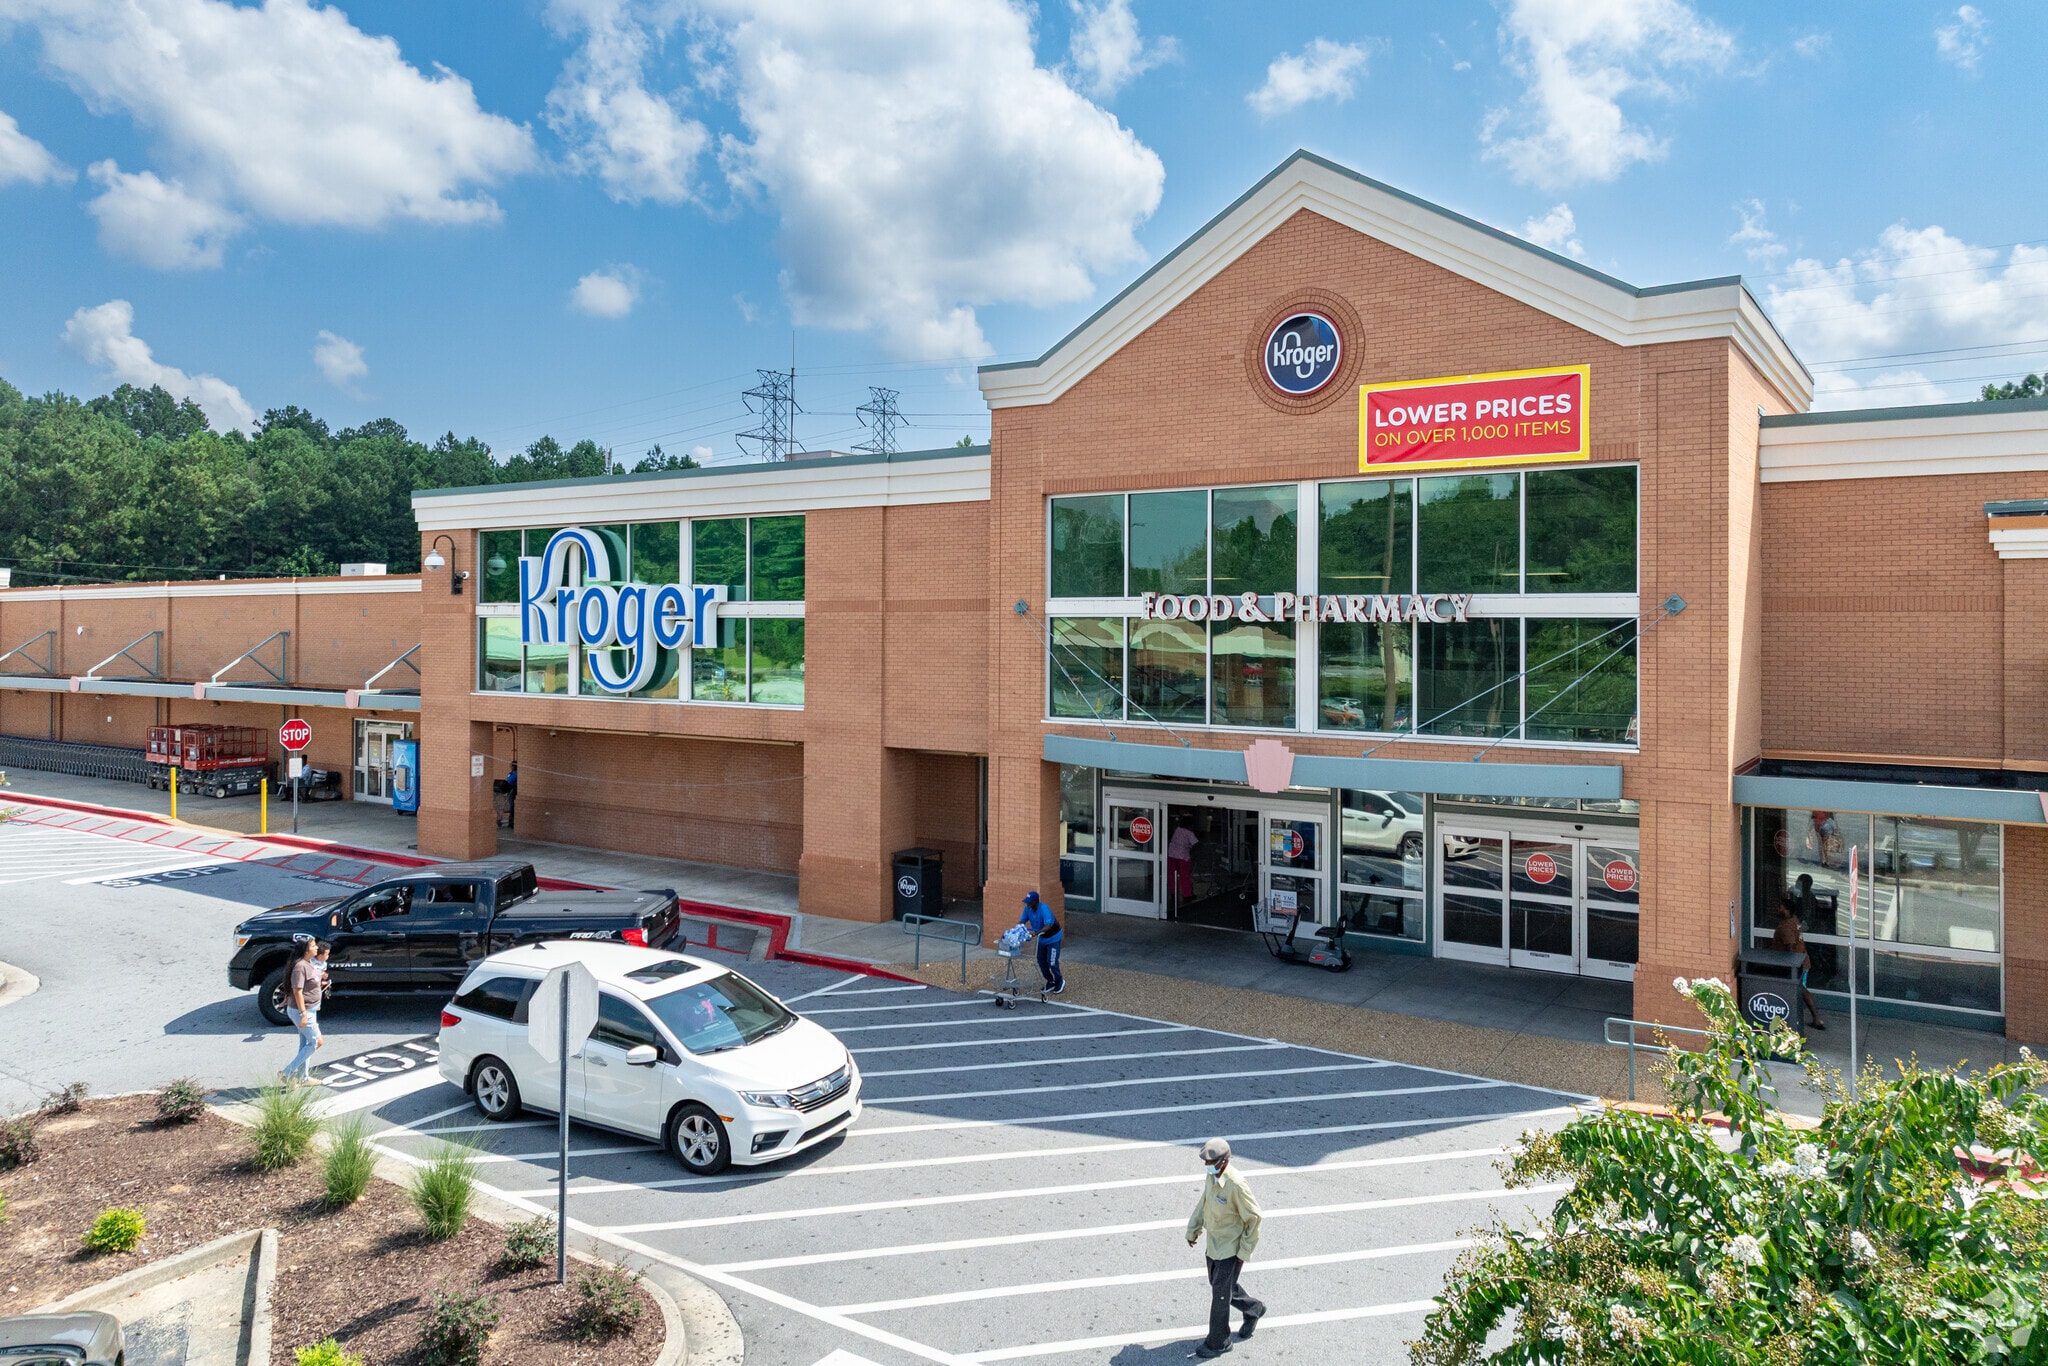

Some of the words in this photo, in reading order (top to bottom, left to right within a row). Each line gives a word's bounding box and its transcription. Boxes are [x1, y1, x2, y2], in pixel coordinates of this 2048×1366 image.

[1273, 331, 1334, 378] Kroger
[1375, 402, 1467, 427] LOWER
[1475, 394, 1572, 420] PRICES
[1375, 432, 1401, 447] ON
[1406, 427, 1456, 444] OVER
[1461, 423, 1509, 443] 1,000
[1514, 419, 1571, 437] ITEMS
[518, 528, 729, 694] Kroger
[1140, 592, 1234, 622] FOOD
[1238, 592, 1273, 622] &
[1274, 592, 1473, 624] PHARMACY
[282, 728, 309, 742] STOP
[101, 865, 220, 887] STOP
[1606, 867, 1633, 875] LOWER
[1606, 873, 1633, 881] PRICES
[1753, 997, 1787, 1020] Kroger
[322, 1036, 440, 1087] TOP
